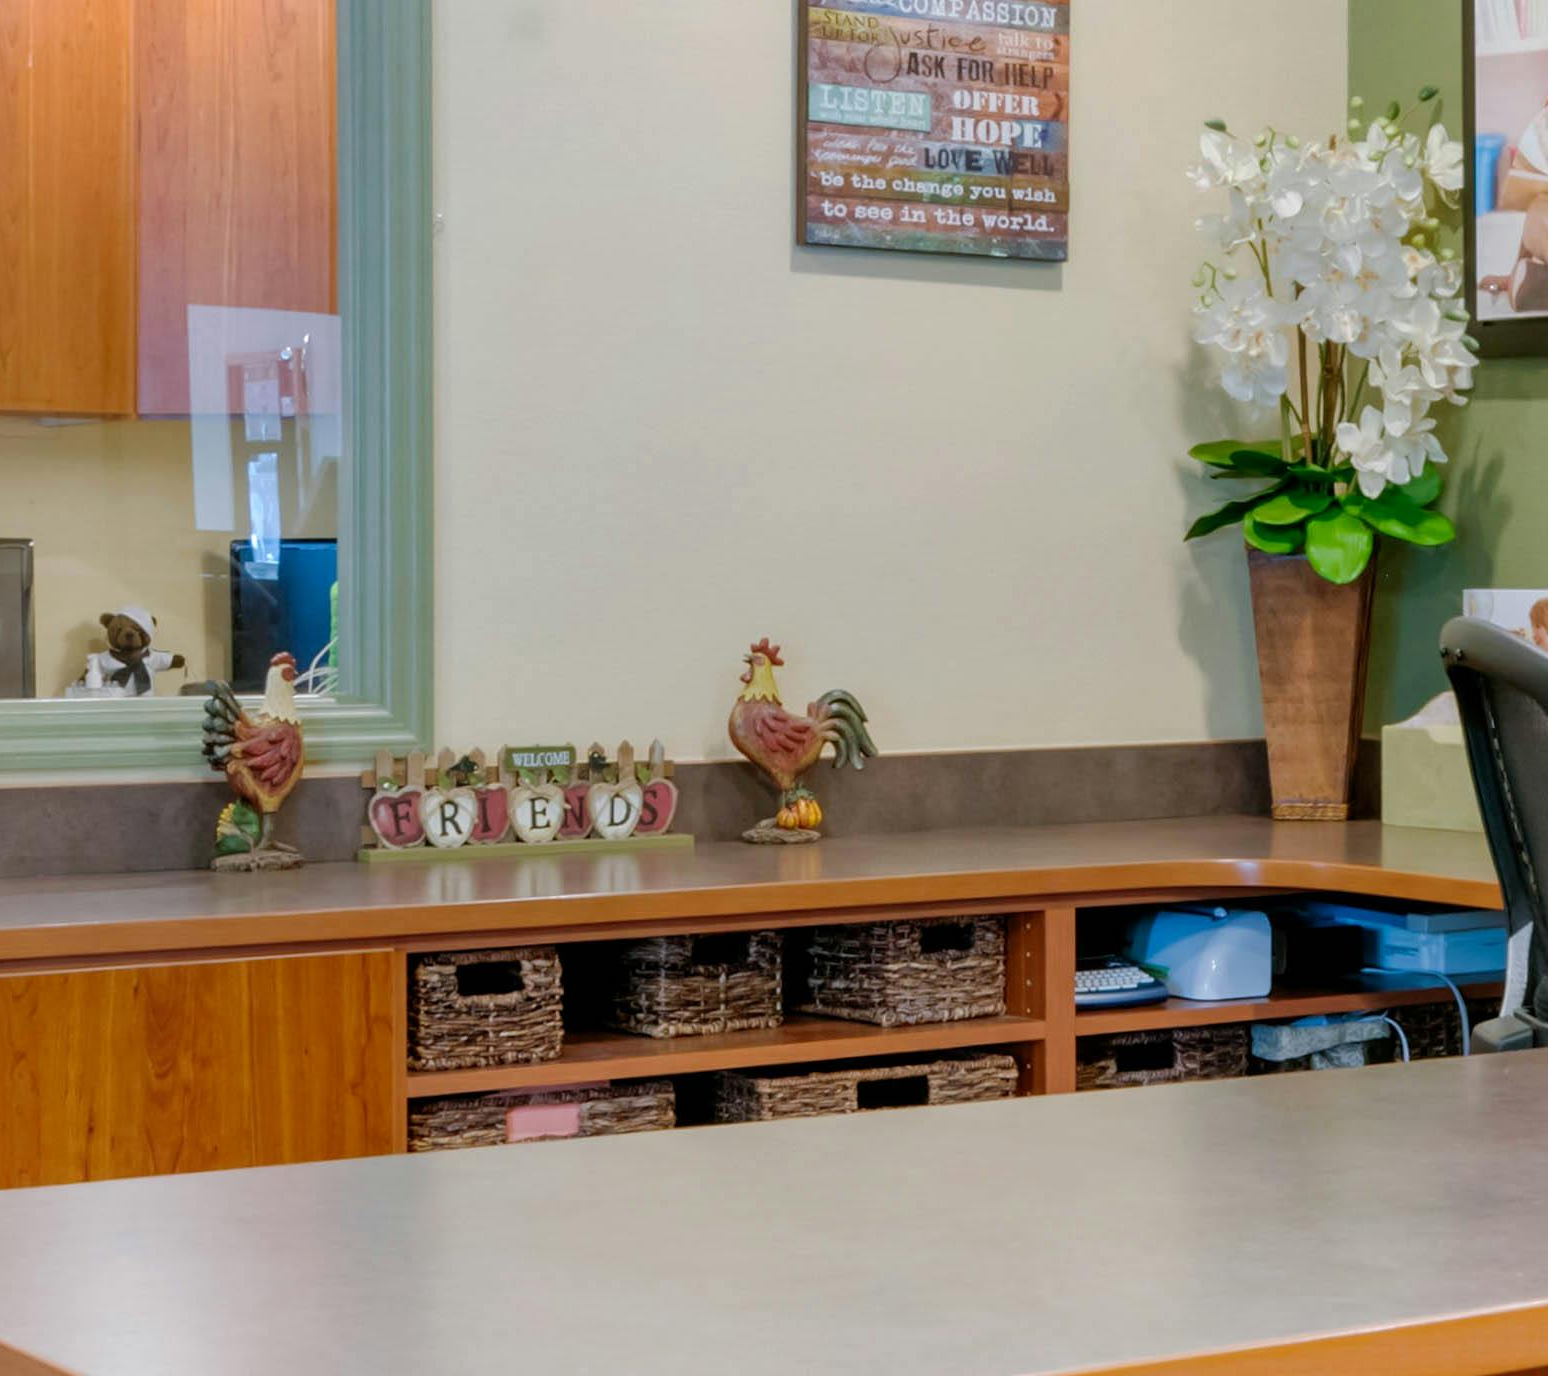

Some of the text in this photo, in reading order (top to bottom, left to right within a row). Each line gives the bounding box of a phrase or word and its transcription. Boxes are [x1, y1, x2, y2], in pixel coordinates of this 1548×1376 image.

[907, 52, 1053, 88] ASK FOR HELP
[819, 84, 925, 117] LISTEN
[953, 89, 1040, 116] OFFER
[952, 116, 1043, 148] HOPE
[924, 147, 983, 172] LOVE
[994, 150, 1054, 176] WELL
[820, 172, 1057, 204] be the change you wish
[820, 200, 1054, 232] to see in the world.
[512, 750, 570, 768] WELCOME
[390, 790, 660, 837] FRIENDS
